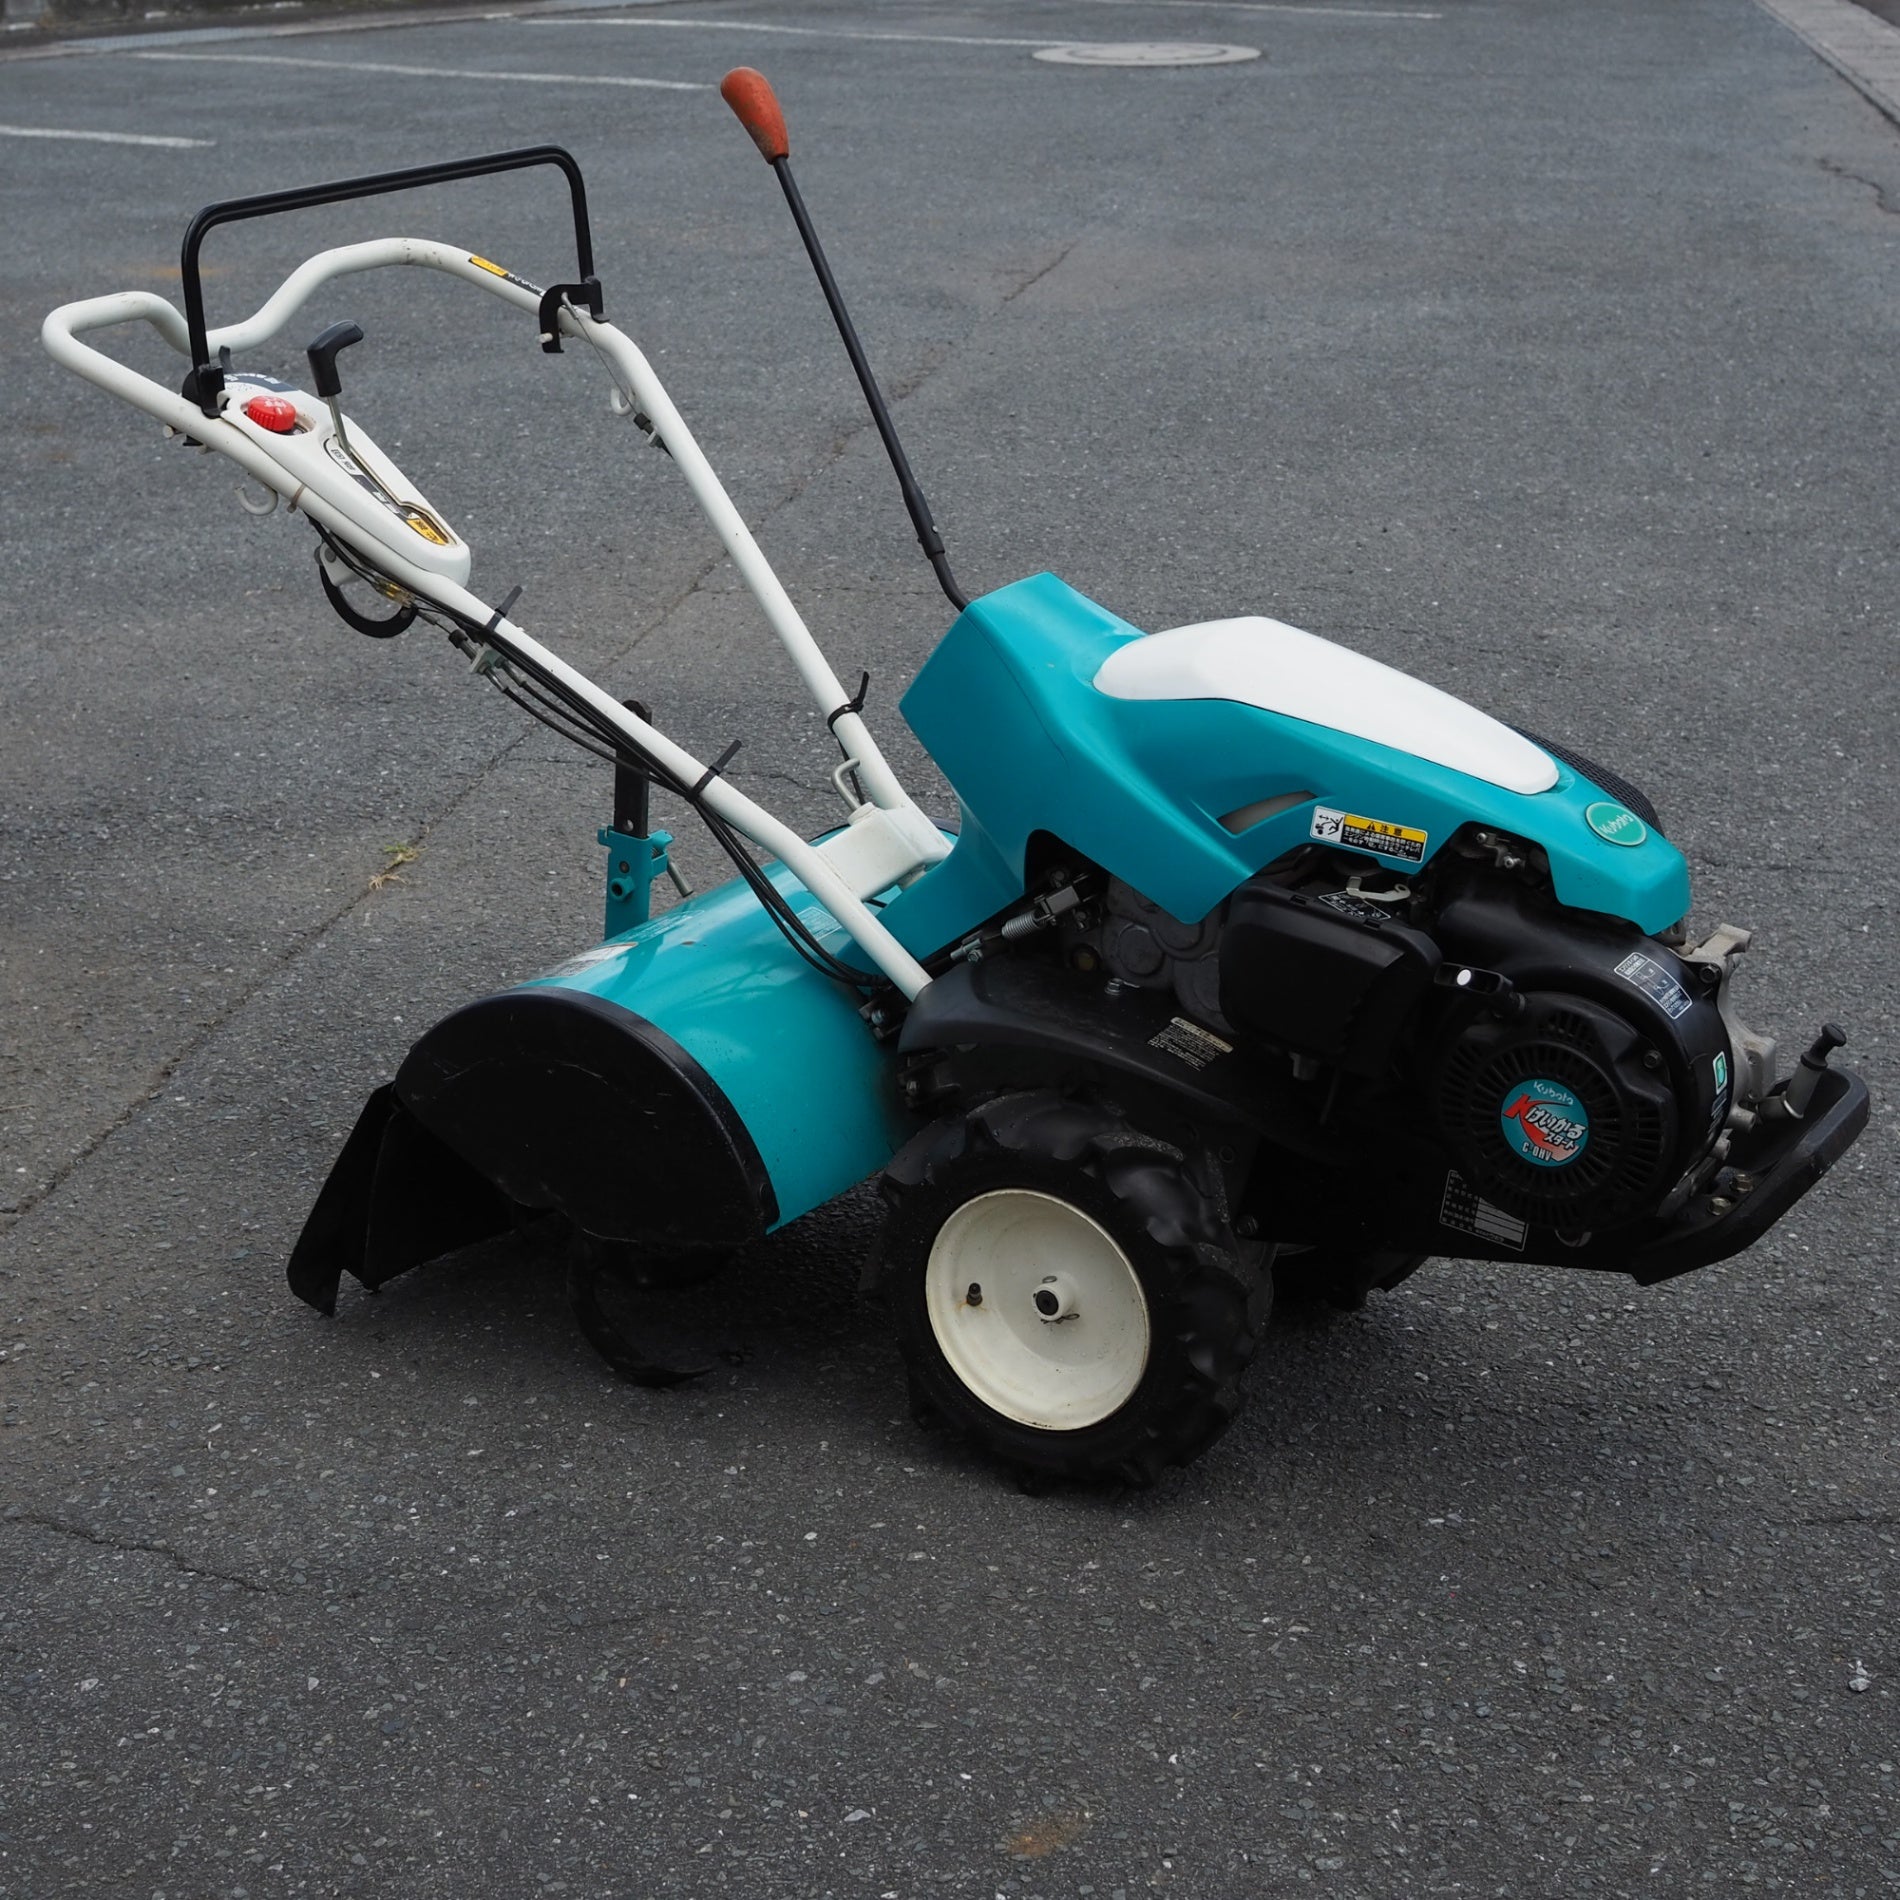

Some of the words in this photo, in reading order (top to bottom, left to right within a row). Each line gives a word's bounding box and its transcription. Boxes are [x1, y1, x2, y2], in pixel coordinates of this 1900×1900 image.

[1599, 814, 1634, 834] Kubota
[1533, 1081, 1574, 1105] Kubota
[1525, 1107, 1586, 1139] けいかる
[1544, 1132, 1575, 1150] スタート
